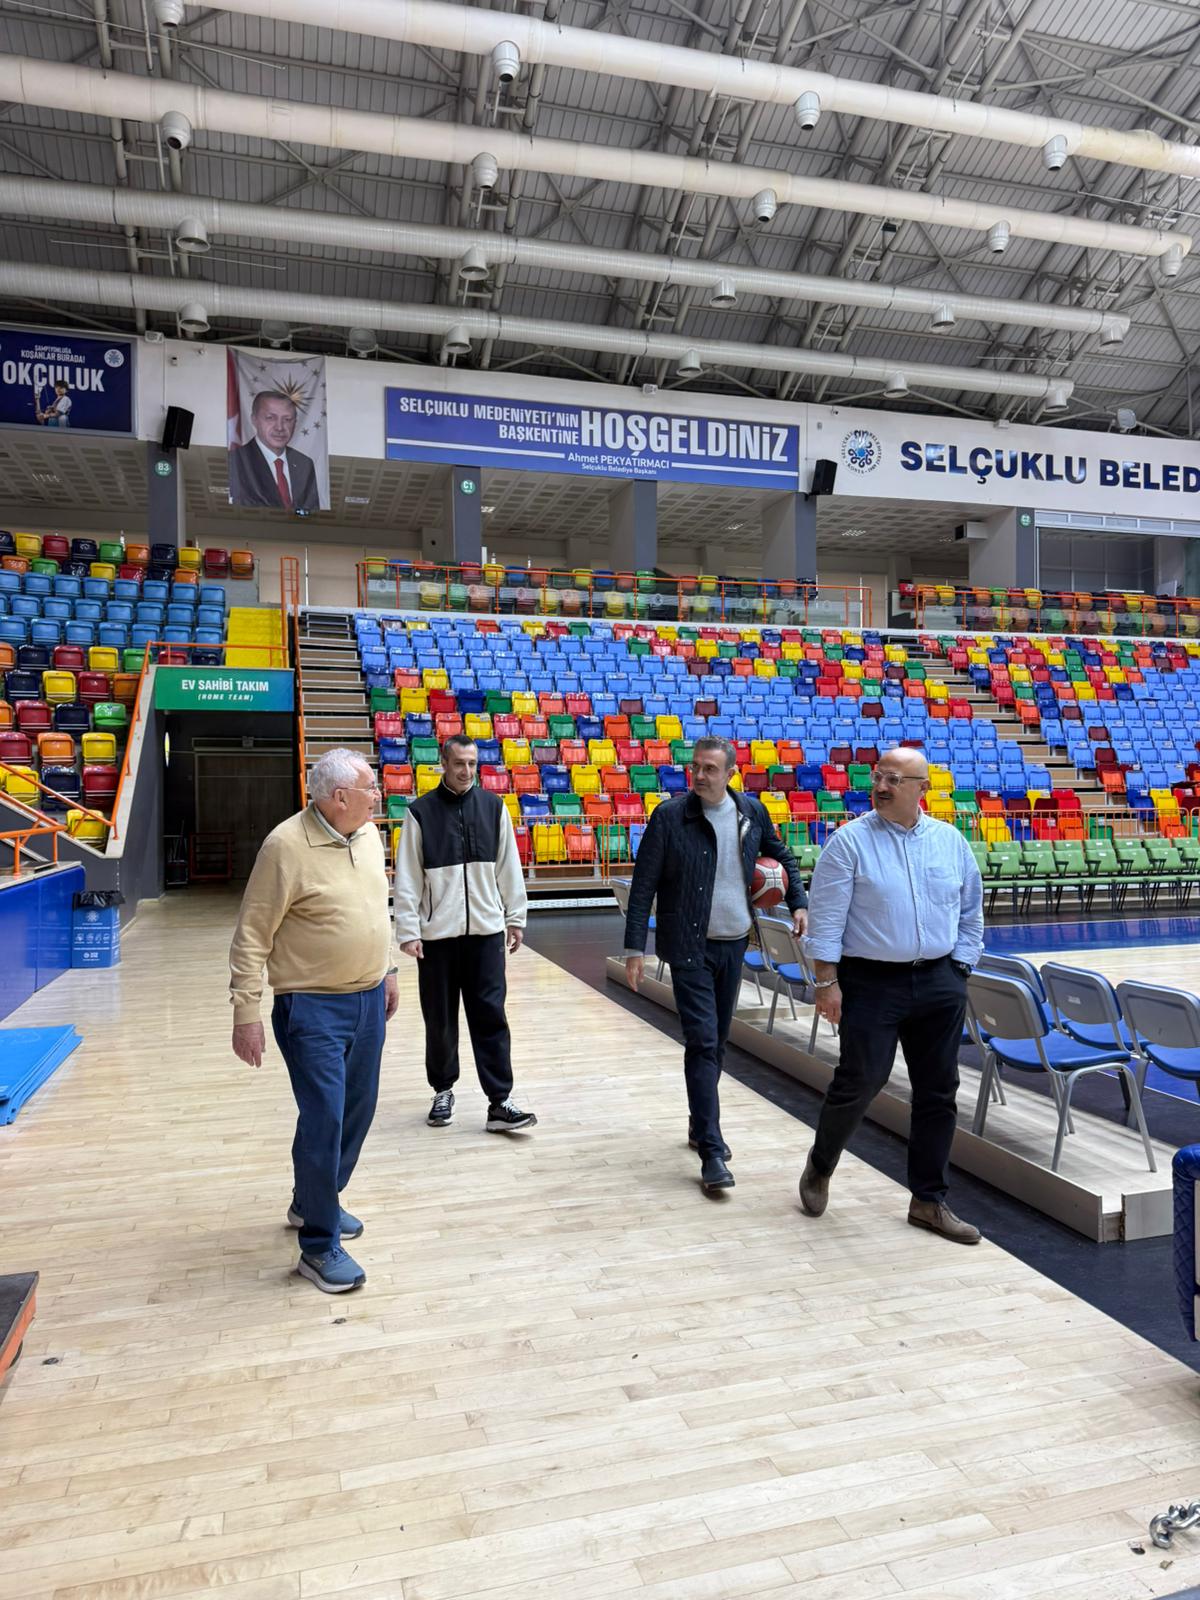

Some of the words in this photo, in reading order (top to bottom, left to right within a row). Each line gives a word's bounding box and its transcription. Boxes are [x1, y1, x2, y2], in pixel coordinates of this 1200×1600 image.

[21, 350, 55, 361] KOŞANLAR
[57, 353, 85, 363] BURADA!
[3, 360, 104, 392] OKÇULUK
[400, 397, 469, 418] SELÇUKLU
[499, 424, 579, 446] BAŞKENTİNE
[581, 410, 788, 462] HOŞGELDİNİZ
[568, 452, 599, 464] Ahmet
[600, 455, 669, 469] PEKYATIRMACI
[582, 463, 607, 472] Selçuklu
[608, 465, 633, 474] Belediye
[634, 467, 657, 475] Başkanı
[901, 441, 1087, 485] SELÇUKLU
[1099, 458, 1200, 493] BELED
[181, 680, 196, 690] EV
[198, 677, 233, 691] SAHİBİ
[235, 681, 269, 692] TAKIM
[228, 694, 254, 702] TEAM)
